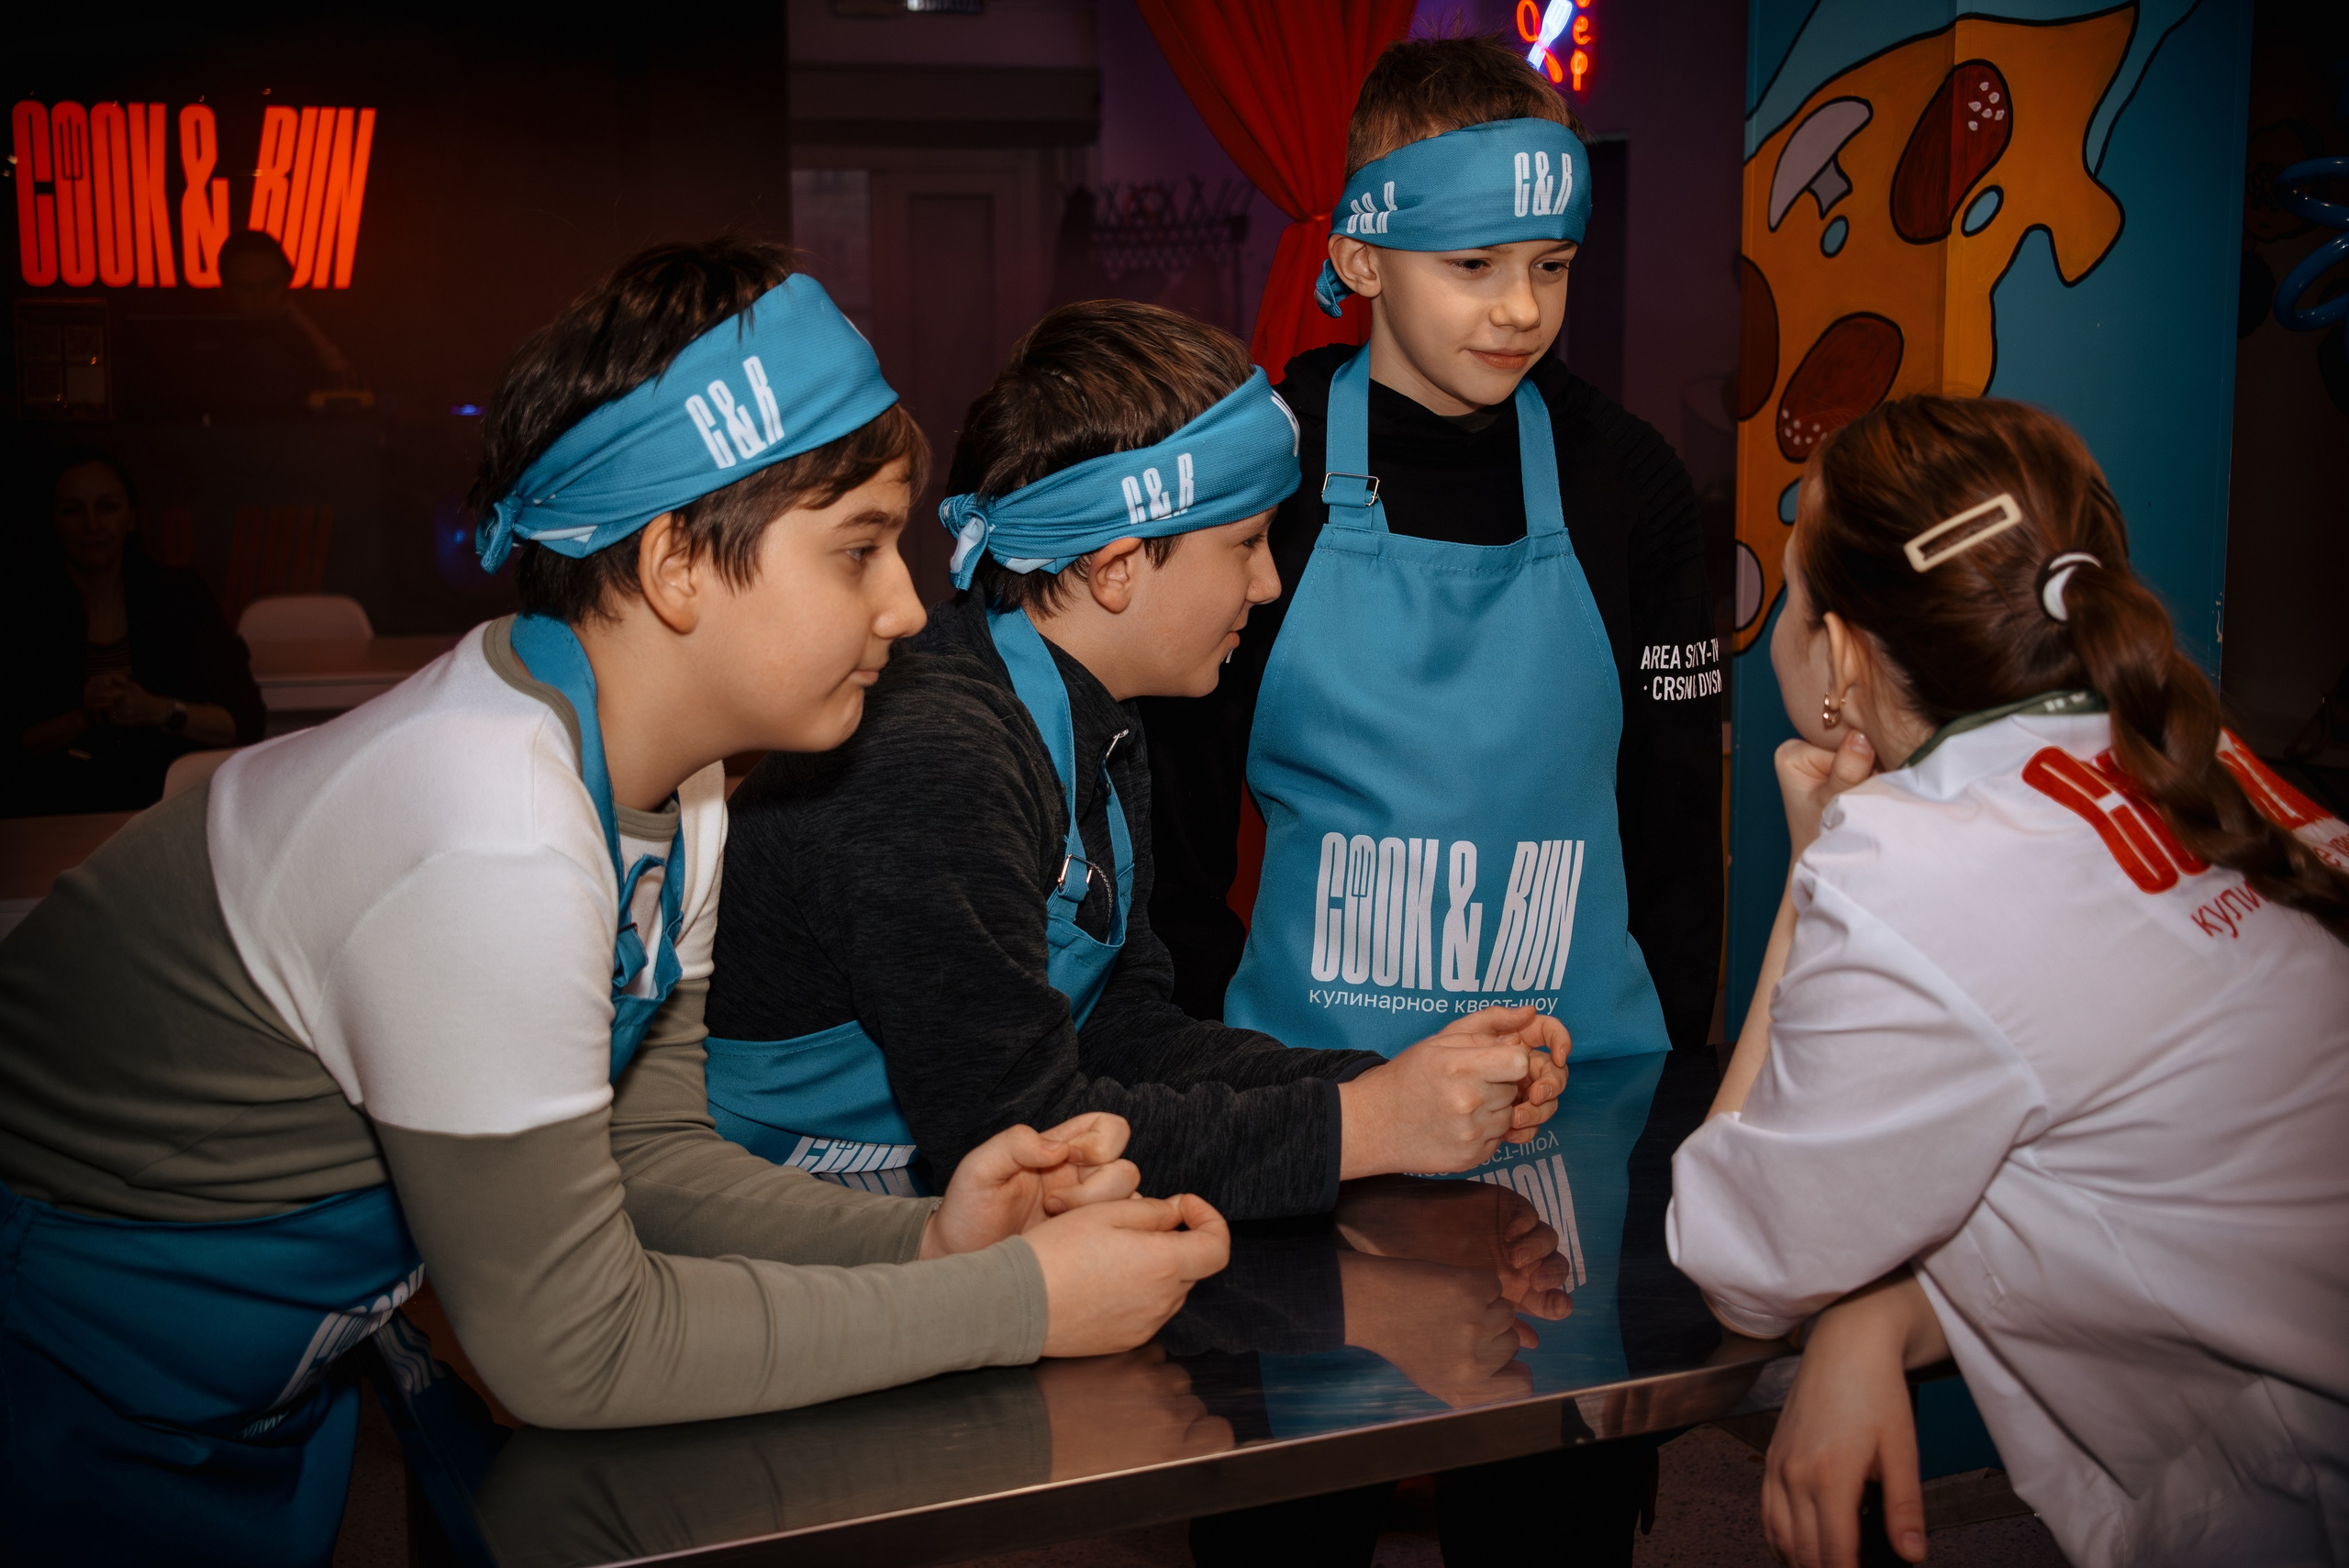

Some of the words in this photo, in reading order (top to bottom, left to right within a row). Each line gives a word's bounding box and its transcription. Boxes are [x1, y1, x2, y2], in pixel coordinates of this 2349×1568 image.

[11, 100, 177, 287] COOK
[178, 104, 230, 288] &
[248, 106, 377, 289] RUN
[1514, 151, 1573, 217] C&R
[685, 356, 785, 469] C&R
[1121, 453, 1195, 525] C&R
[1641, 645, 1681, 670] AREA
[1310, 832, 1440, 990] COOK
[1441, 840, 1483, 992] &
[1482, 840, 1585, 992] RUN
[1308, 988, 1449, 1014] кулинарное
